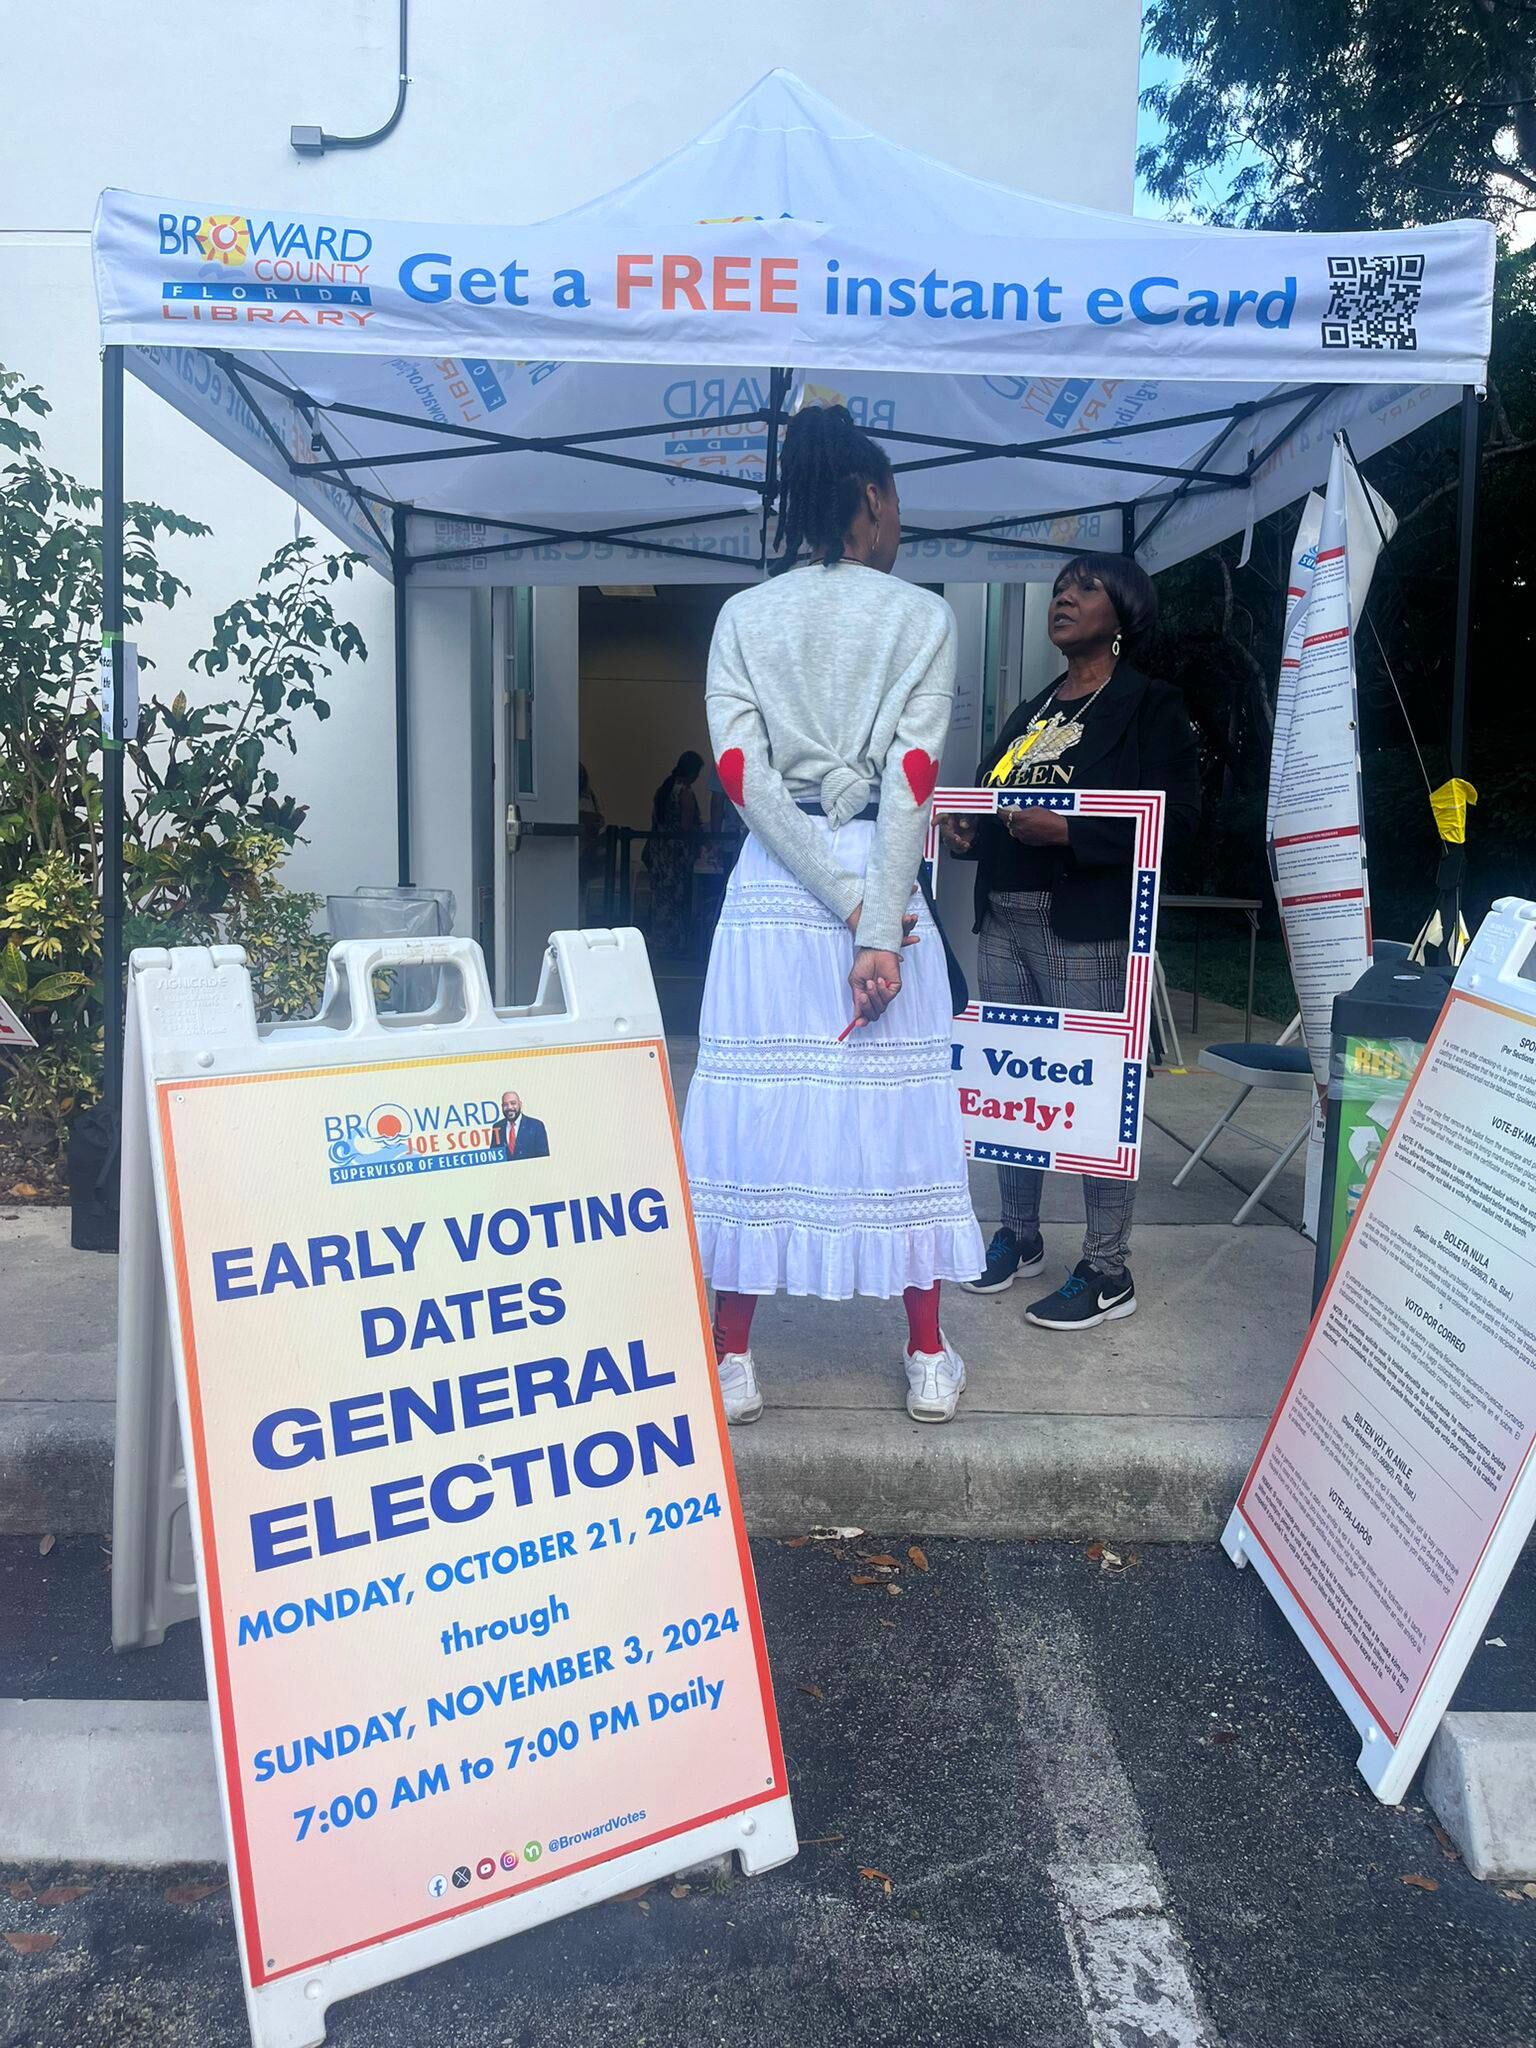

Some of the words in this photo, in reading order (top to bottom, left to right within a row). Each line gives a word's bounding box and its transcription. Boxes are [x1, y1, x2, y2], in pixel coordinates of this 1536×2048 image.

[171, 284, 364, 304] FLORIDA
[255, 259, 370, 285] COUNTY
[399, 254, 529, 306] Get
[552, 267, 591, 308] a
[617, 254, 798, 315] FREE
[826, 259, 1063, 324] instant
[1086, 276, 1297, 329] eCard
[161, 305, 377, 327] LIBRARY
[983, 1047, 1094, 1086] Voted
[959, 1087, 1076, 1131] Early!
[332, 1160, 414, 1182] SUPERVISOR
[418, 1157, 434, 1172] OF
[438, 1149, 505, 1168] ELECTIONS
[406, 1134, 440, 1156] JOE
[446, 1126, 502, 1150] SCOTT
[211, 1221, 426, 1302] EARLY
[443, 1187, 669, 1263] VOTING
[1443, 1230, 1470, 1255] BOLETA
[1469, 1248, 1489, 1269] NULA
[360, 1277, 567, 1359] DATES
[1405, 1297, 1423, 1317] VOTO
[1422, 1311, 1438, 1330] POR
[1437, 1324, 1466, 1353] CORREO
[252, 1339, 676, 1471] GENERAL
[1354, 1412, 1375, 1438] BILTEN
[1385, 1446, 1394, 1459] KI
[1392, 1455, 1413, 1480] ANILE
[249, 1413, 696, 1573] ELECTION
[237, 1572, 415, 1647] MONDAY,
[425, 1530, 579, 1594] OCTOBER
[588, 1517, 637, 1552] 21,
[645, 1492, 722, 1536] 2024
[440, 1594, 571, 1656] through
[253, 1705, 417, 1783] SUNDAY,
[427, 1644, 615, 1727] NOVEMBER
[624, 1634, 654, 1666] 3,
[663, 1607, 740, 1654] 2024
[293, 1787, 378, 1843] 7:00
[390, 1763, 450, 1812] AM
[459, 1752, 495, 1785] to
[504, 1720, 580, 1772] 7:00
[589, 1701, 640, 1743] PM
[648, 1676, 726, 1726] Daily
[548, 1808, 647, 1852] @BrowardVotes
